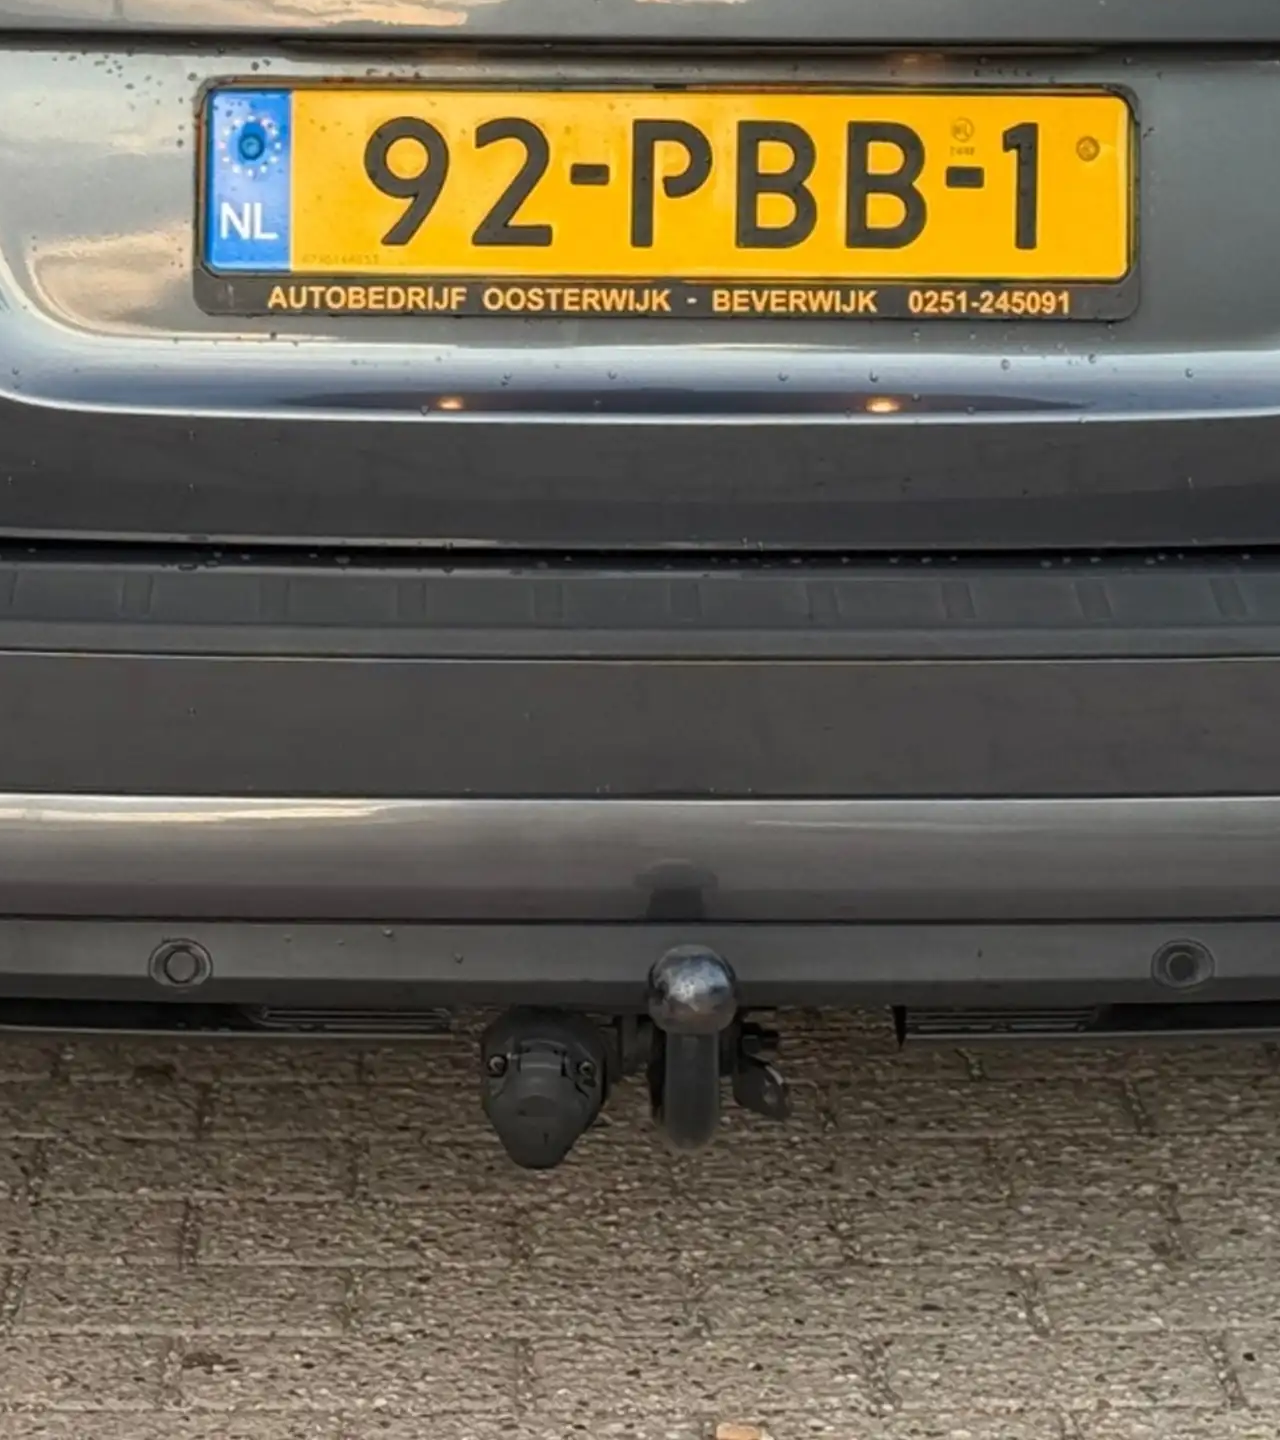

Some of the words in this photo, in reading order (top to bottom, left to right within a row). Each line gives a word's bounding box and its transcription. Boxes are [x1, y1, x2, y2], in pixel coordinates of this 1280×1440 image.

[363, 116, 1040, 250] 92-PBB-1
[220, 201, 280, 241] NL
[267, 285, 468, 311] AUTOBEDRIJF
[482, 286, 672, 312] OOSTERWIJK
[711, 289, 878, 314] BEVERWIJK
[907, 290, 1072, 315] 0251-245091
